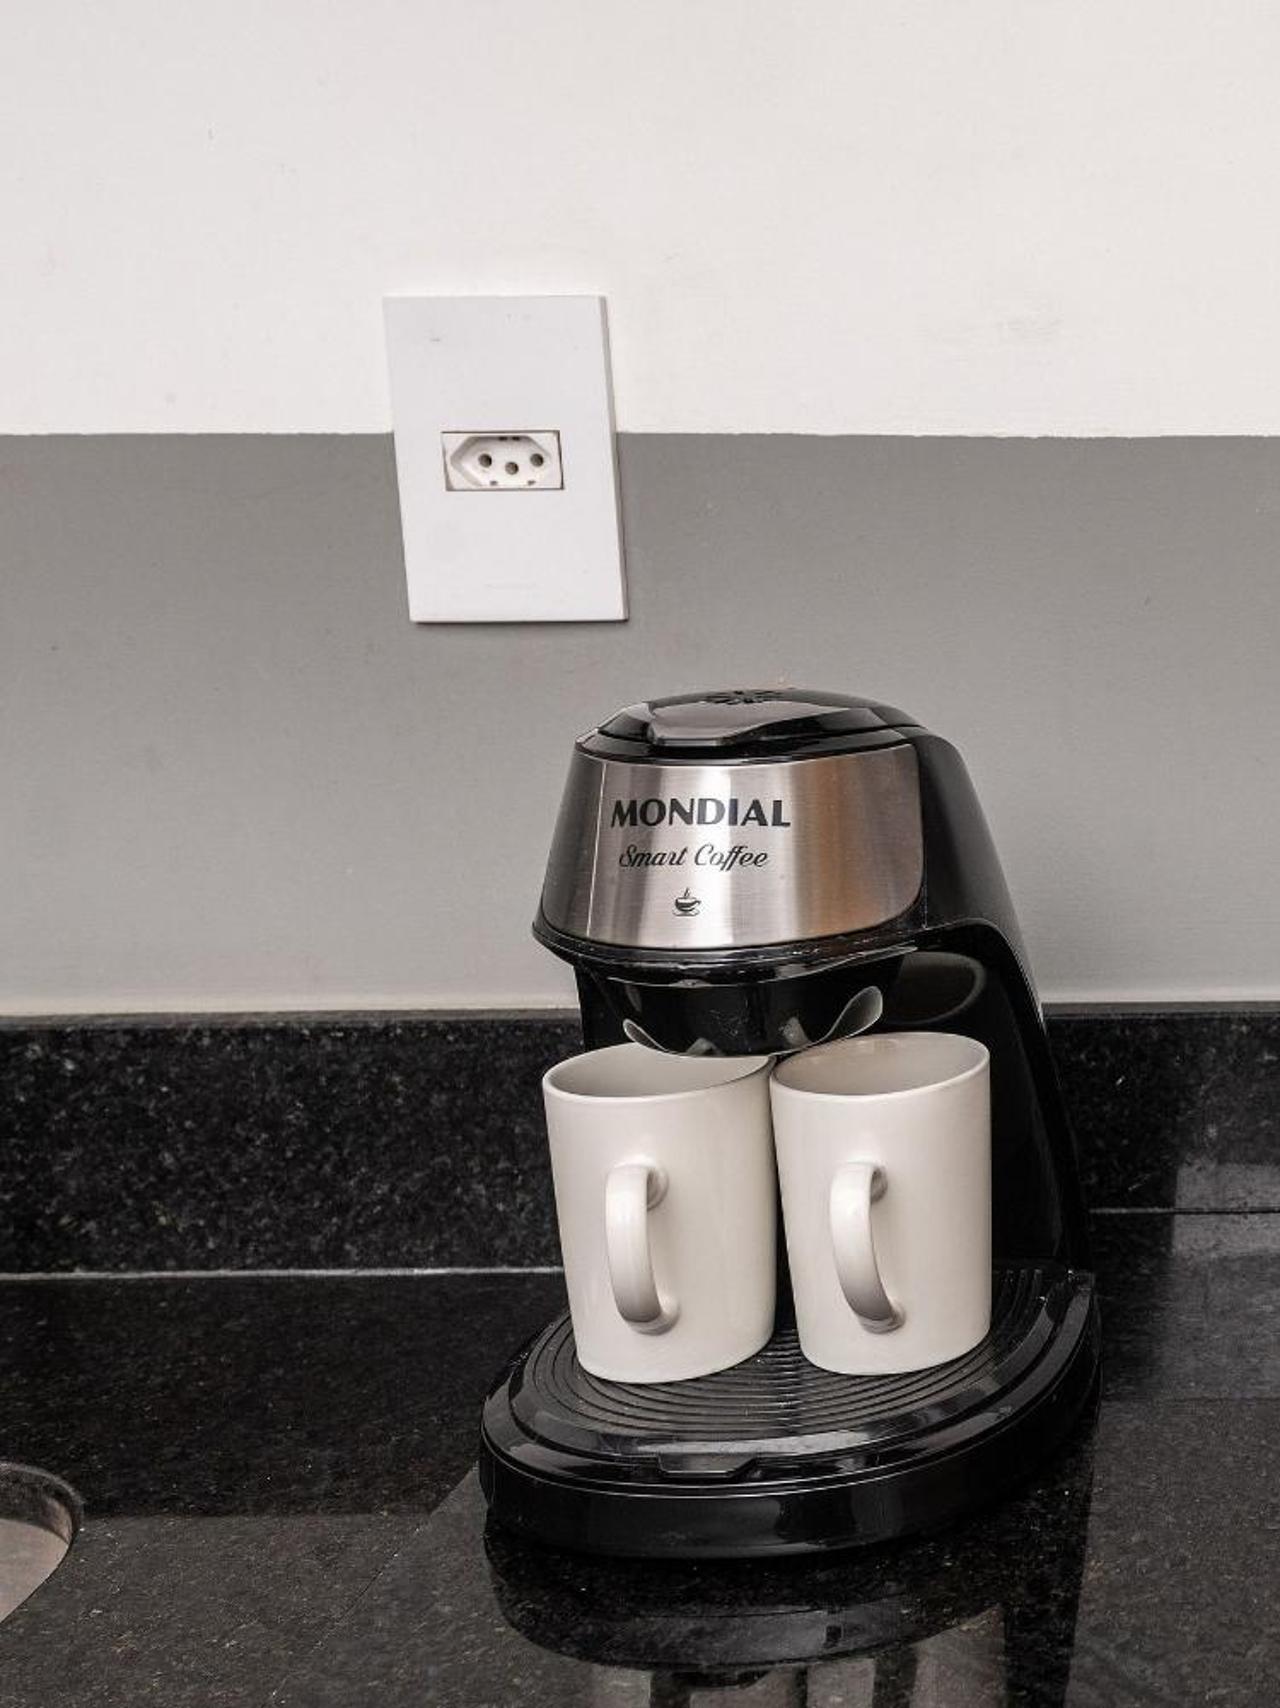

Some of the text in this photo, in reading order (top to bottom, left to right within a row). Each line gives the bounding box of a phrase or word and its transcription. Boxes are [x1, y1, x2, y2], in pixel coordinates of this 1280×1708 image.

[611, 798, 791, 828] MONDIAL
[619, 844, 769, 871] Smart Coffee
